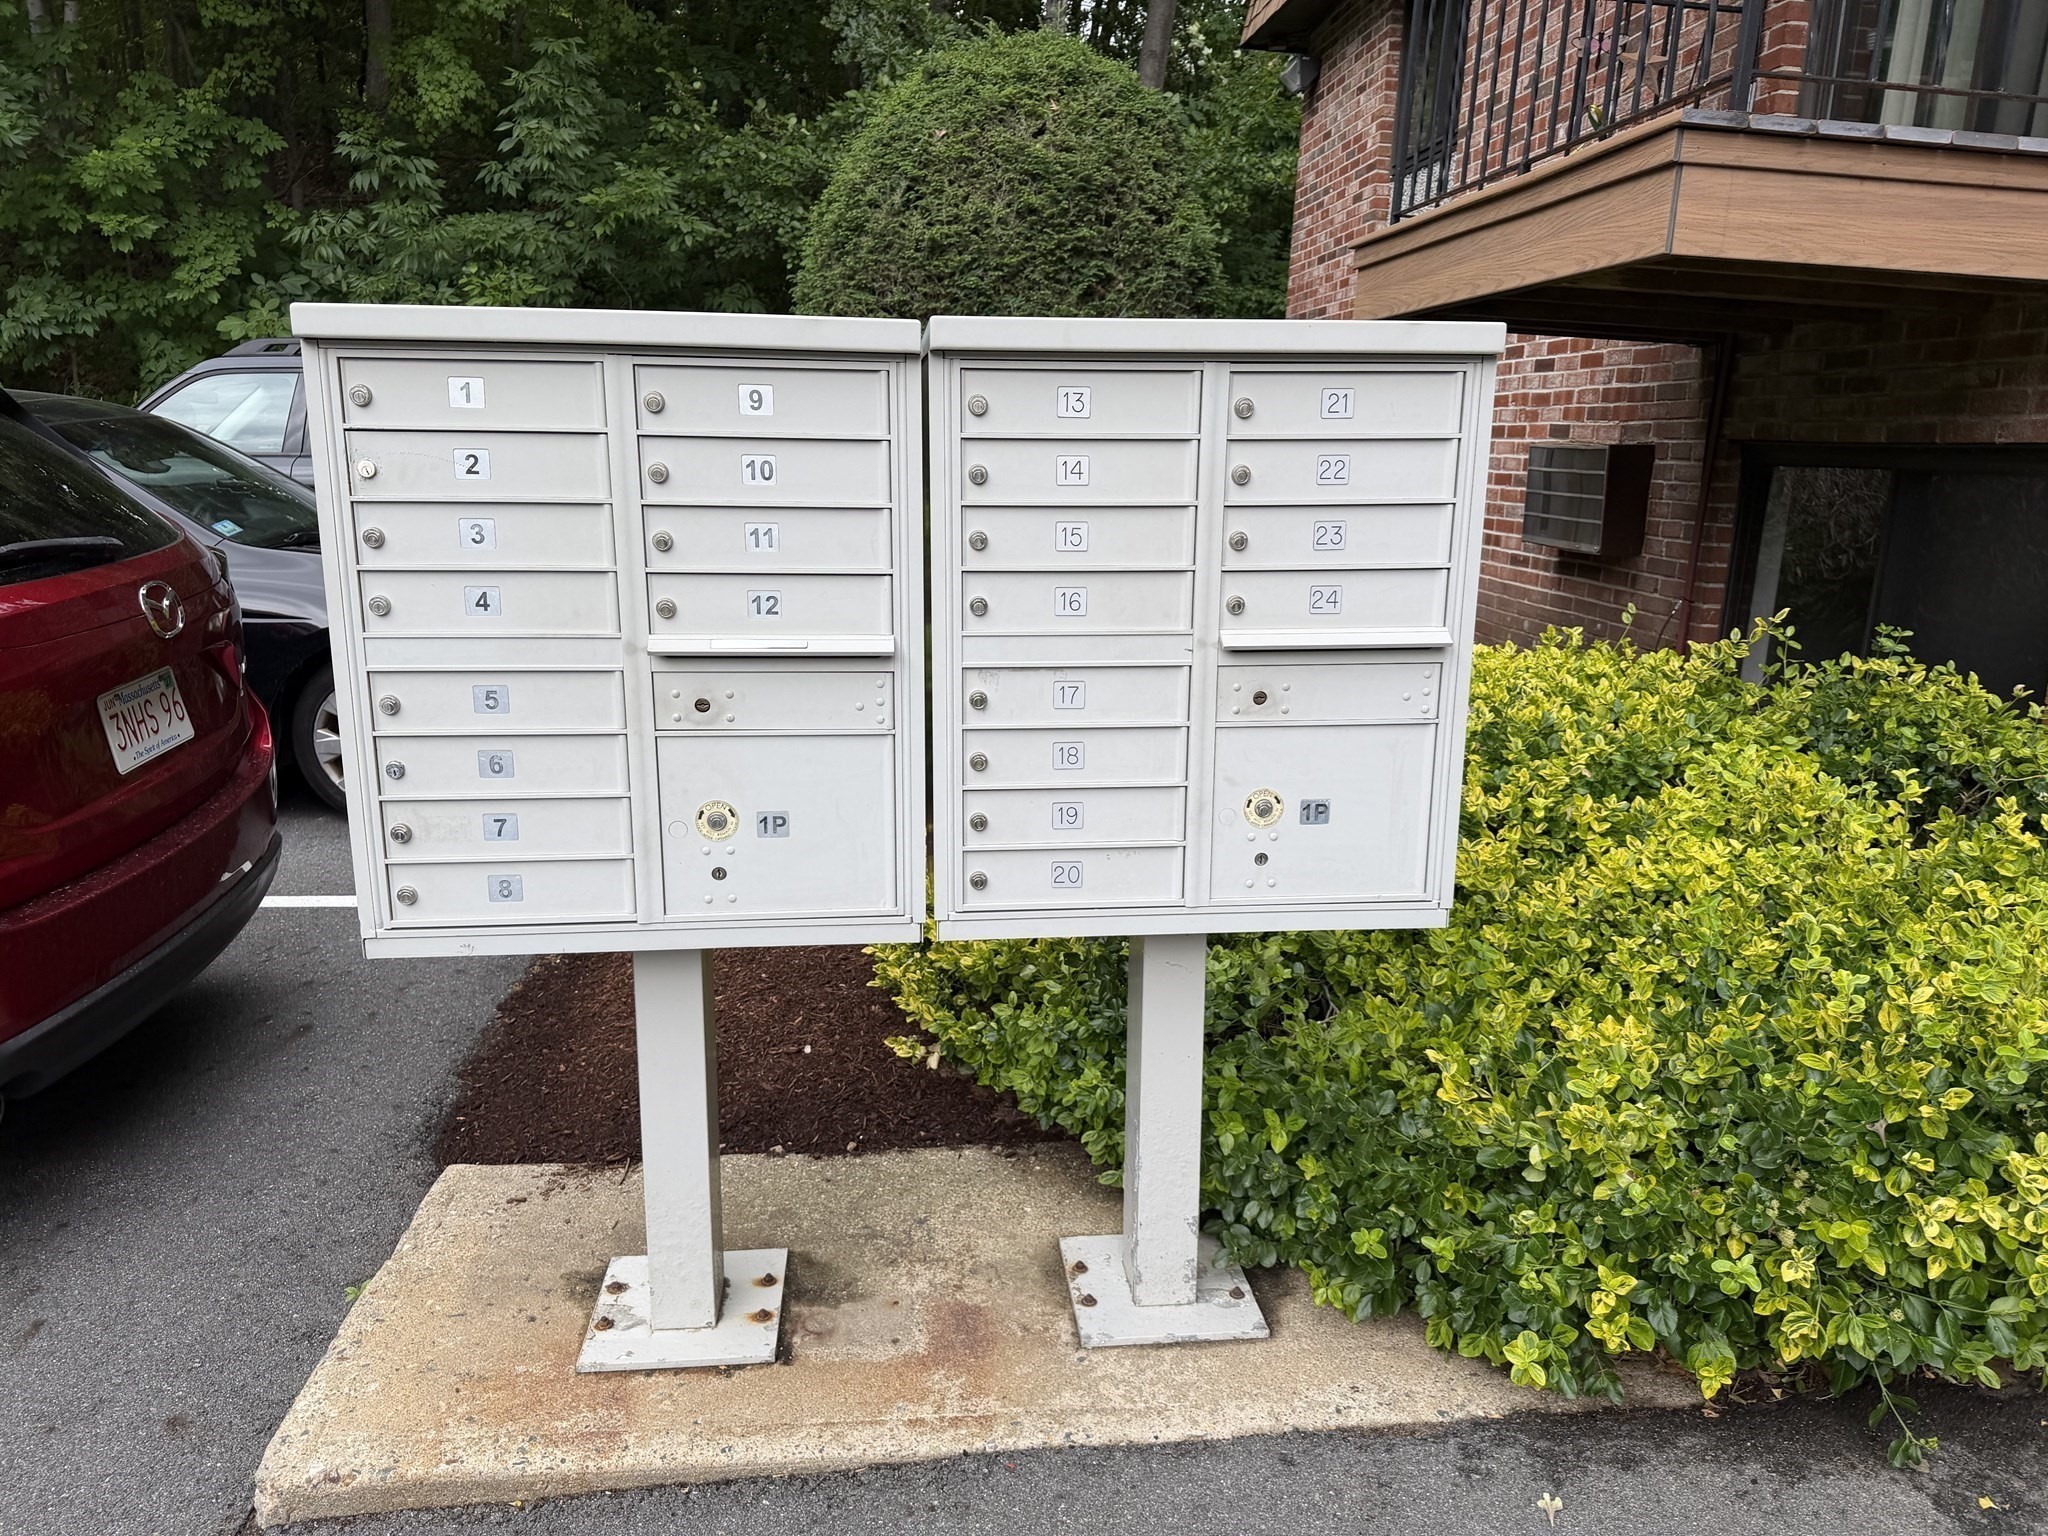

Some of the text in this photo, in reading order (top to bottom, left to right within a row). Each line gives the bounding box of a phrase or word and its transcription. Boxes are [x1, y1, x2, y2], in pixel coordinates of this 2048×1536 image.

[460, 382, 470, 403] 1
[749, 390, 763, 410] 9
[1064, 392, 1084, 413] 13
[1328, 393, 1347, 413] 21
[465, 454, 480, 475] 2
[746, 460, 773, 481] 10
[1062, 461, 1083, 480] 14
[1320, 460, 1345, 479] 22
[471, 524, 485, 544] 3
[750, 528, 773, 548] 11
[1062, 527, 1082, 546] 15
[1316, 526, 1342, 545] 23
[475, 592, 490, 611] 4
[752, 596, 778, 615] 12
[1061, 592, 1081, 611] 16
[1312, 590, 1338, 609] 24
[117, 680, 161, 705] Massachusetts
[485, 691, 499, 709] 5
[1060, 686, 1079, 704] 17
[103, 697, 116, 711] JUN
[109, 687, 185, 751] 3NHS 96
[135, 734, 178, 759] The Spirit of America
[1059, 747, 1078, 764] 18
[490, 756, 503, 774] 6
[705, 802, 728, 811] OPEN
[1058, 807, 1077, 824] 19
[1303, 804, 1328, 821] 1P
[494, 819, 507, 837] 7
[760, 816, 786, 833] 1P
[1054, 866, 1080, 883] 20
[499, 880, 512, 898] 8
